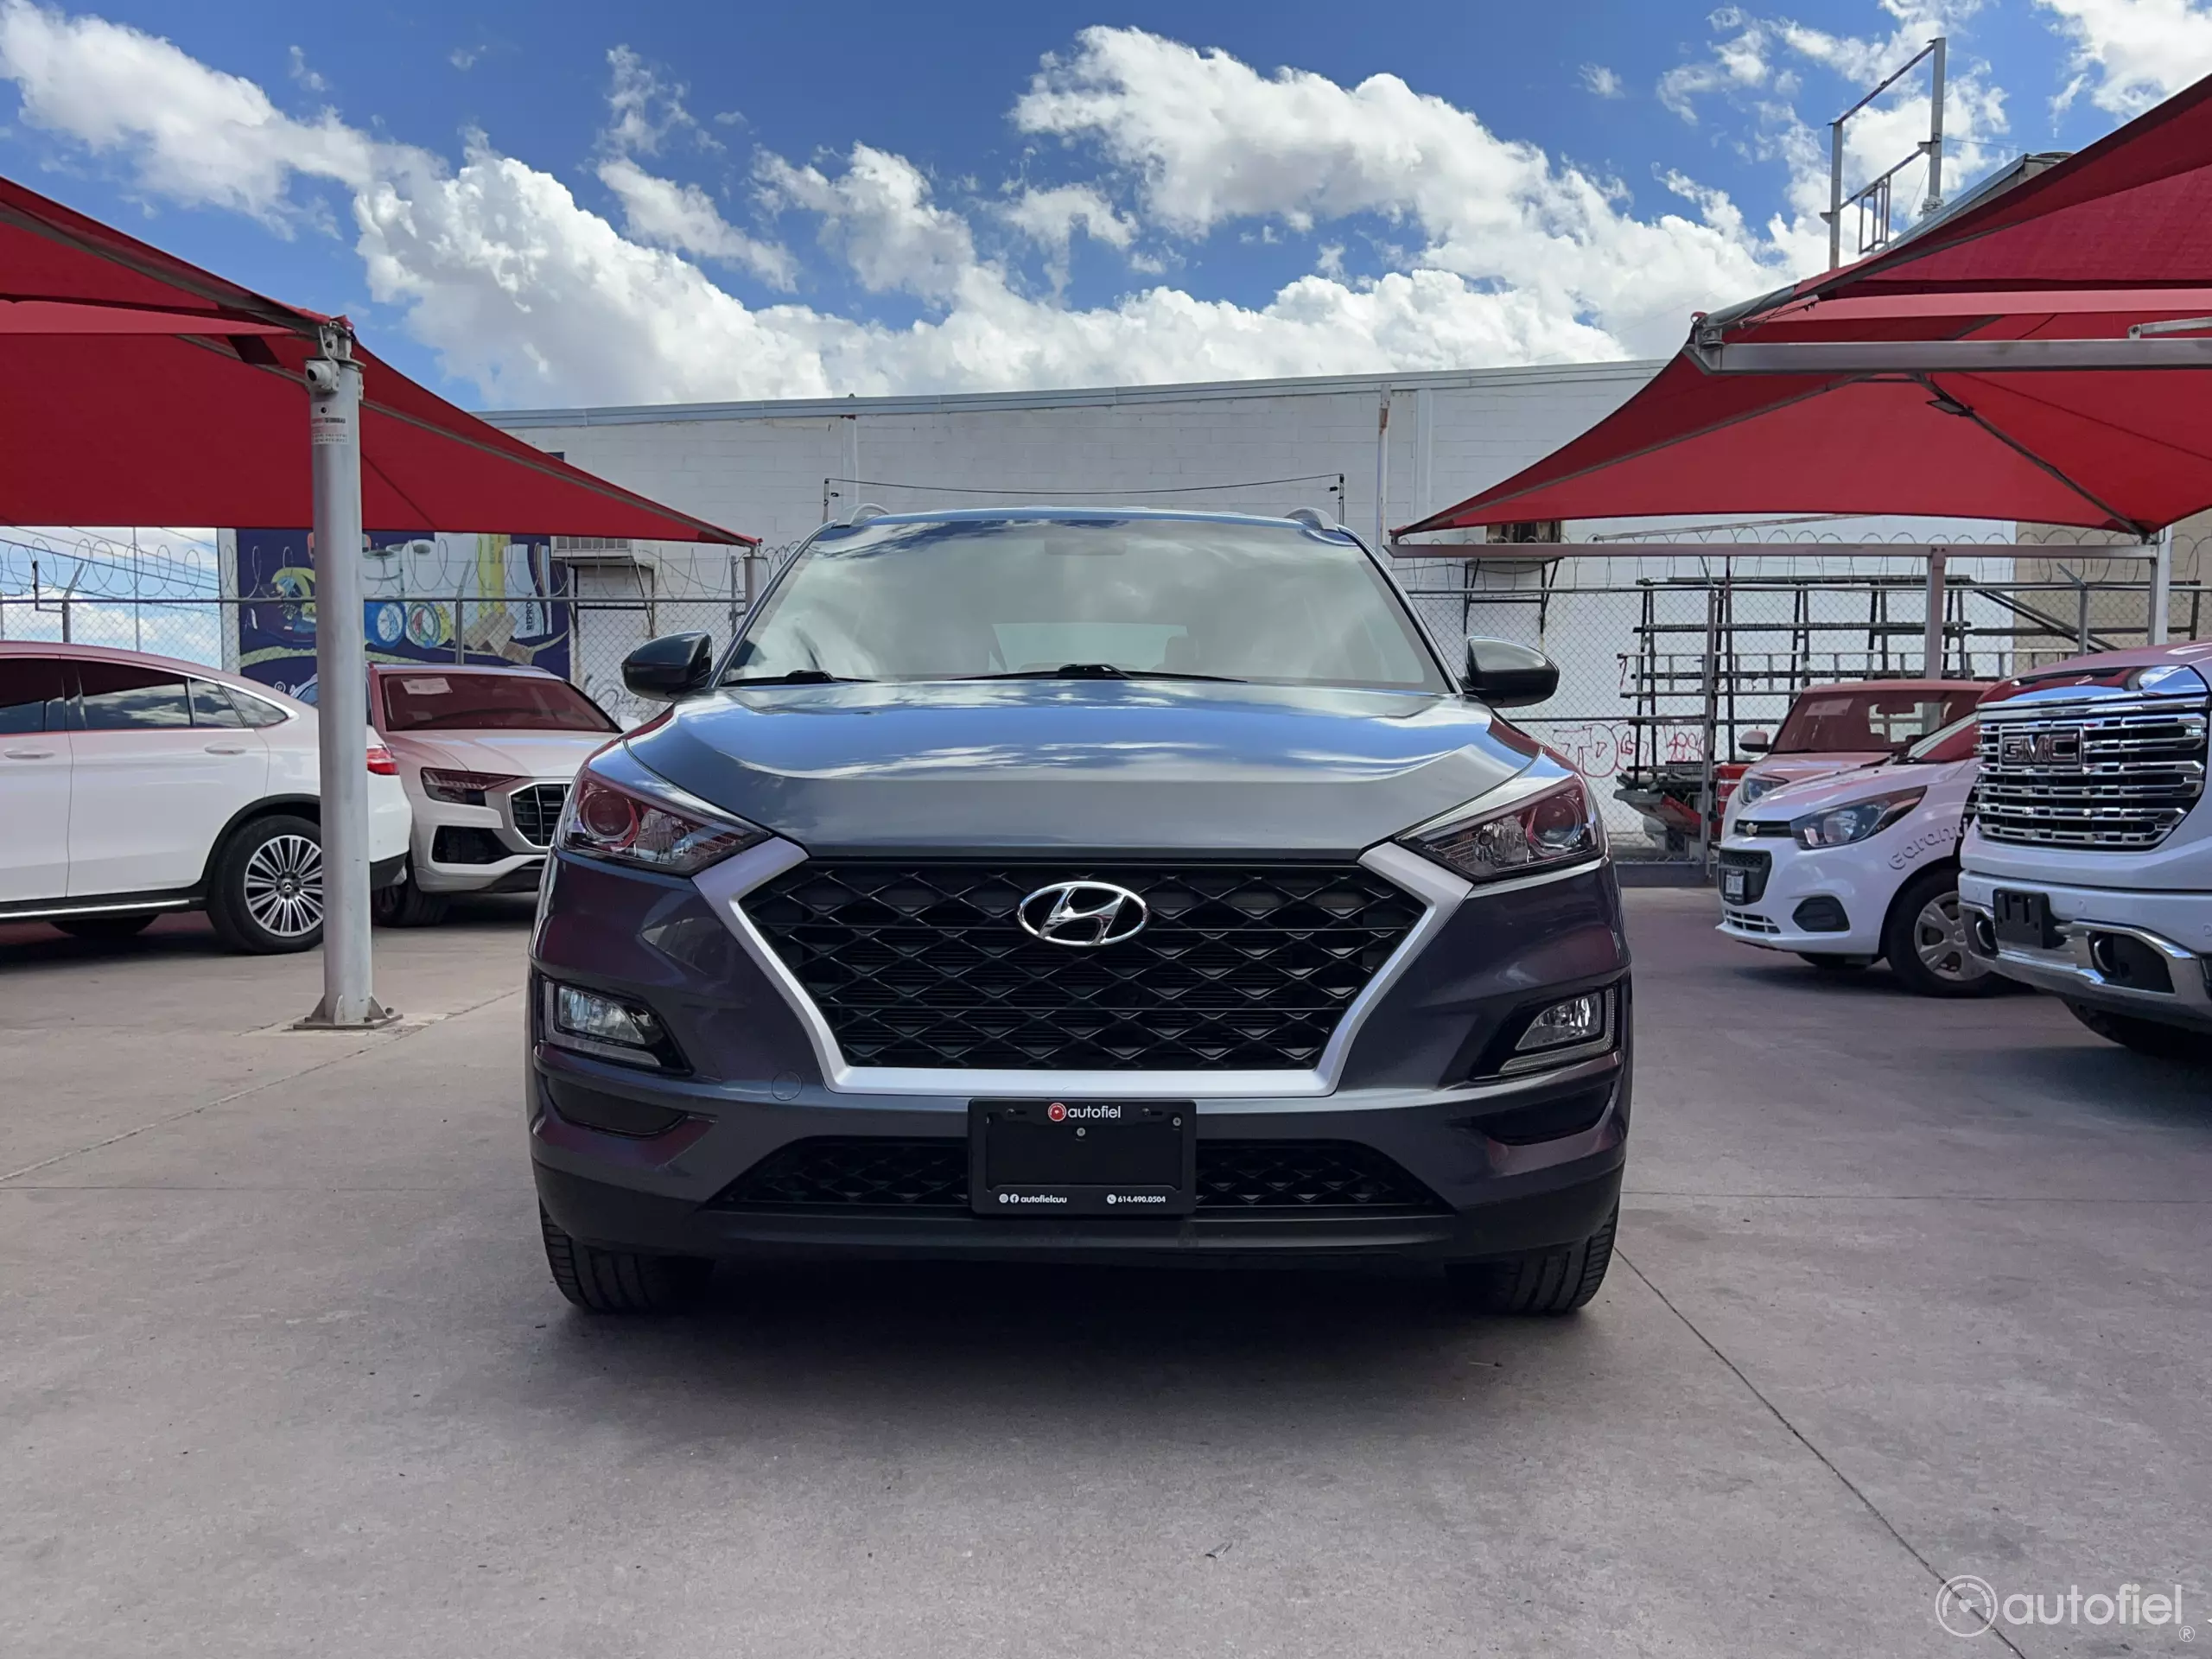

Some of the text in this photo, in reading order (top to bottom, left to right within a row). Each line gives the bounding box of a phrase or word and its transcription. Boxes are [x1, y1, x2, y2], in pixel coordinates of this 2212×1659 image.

[2002, 734, 2078, 763] GMC
[1068, 1105, 1121, 1119] autofiel
[1020, 1194, 1067, 1204] autofielcuu
[1117, 1195, 1166, 1204] 614.490.0504
